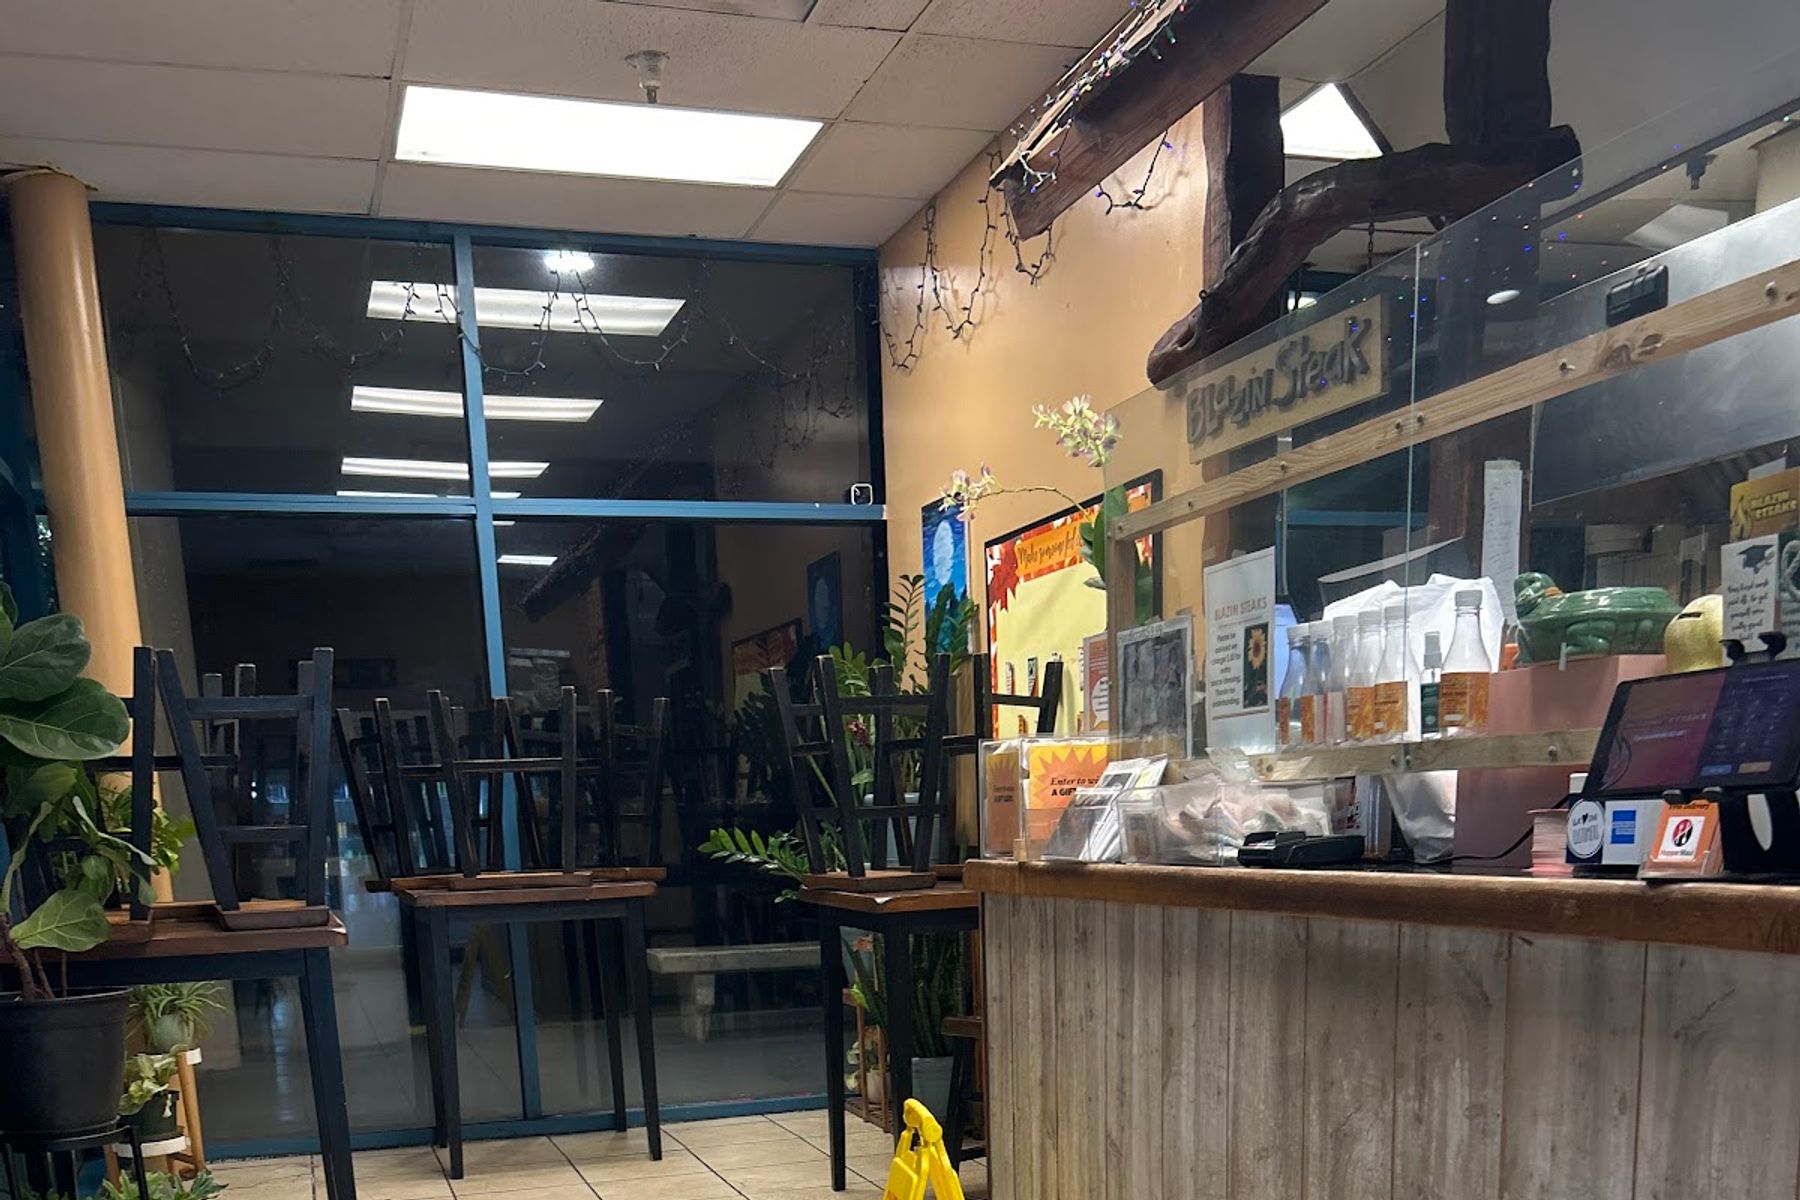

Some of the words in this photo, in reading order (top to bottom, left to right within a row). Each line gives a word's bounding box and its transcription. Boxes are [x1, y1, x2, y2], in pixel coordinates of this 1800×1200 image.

[1050, 777, 1075, 786] Enter
[1077, 777, 1086, 785] to
[1051, 788, 1058, 796] A
